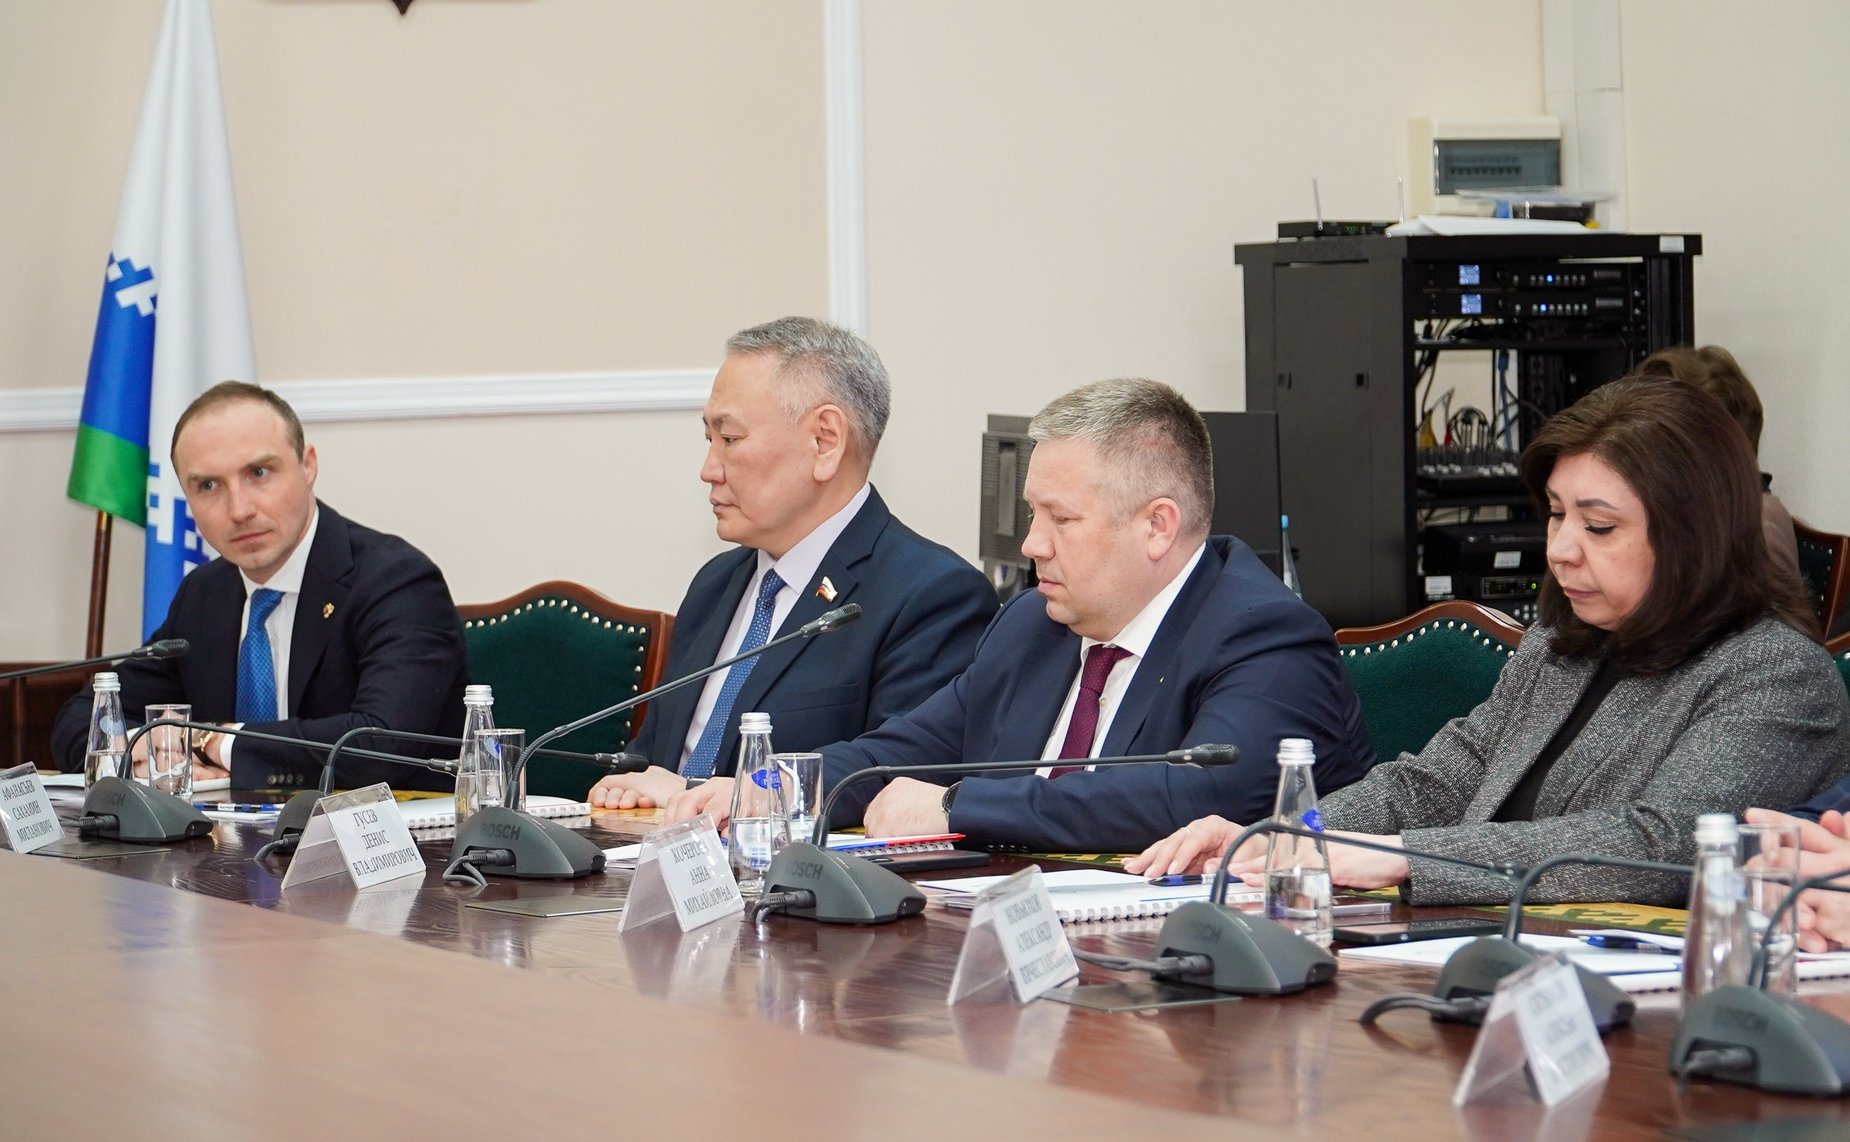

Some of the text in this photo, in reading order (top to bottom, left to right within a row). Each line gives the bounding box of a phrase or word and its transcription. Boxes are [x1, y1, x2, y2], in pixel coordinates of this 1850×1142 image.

[2, 780, 35, 800] АФАНАСЬЕВ
[353, 809, 378, 829] ГУСЕВ
[361, 830, 390, 850] ДЕНИС
[480, 822, 521, 840] BOSCH
[352, 847, 418, 876] ВЛАДИМИРОВИЧ
[785, 858, 823, 880] OSCH
[689, 865, 711, 886] АННА
